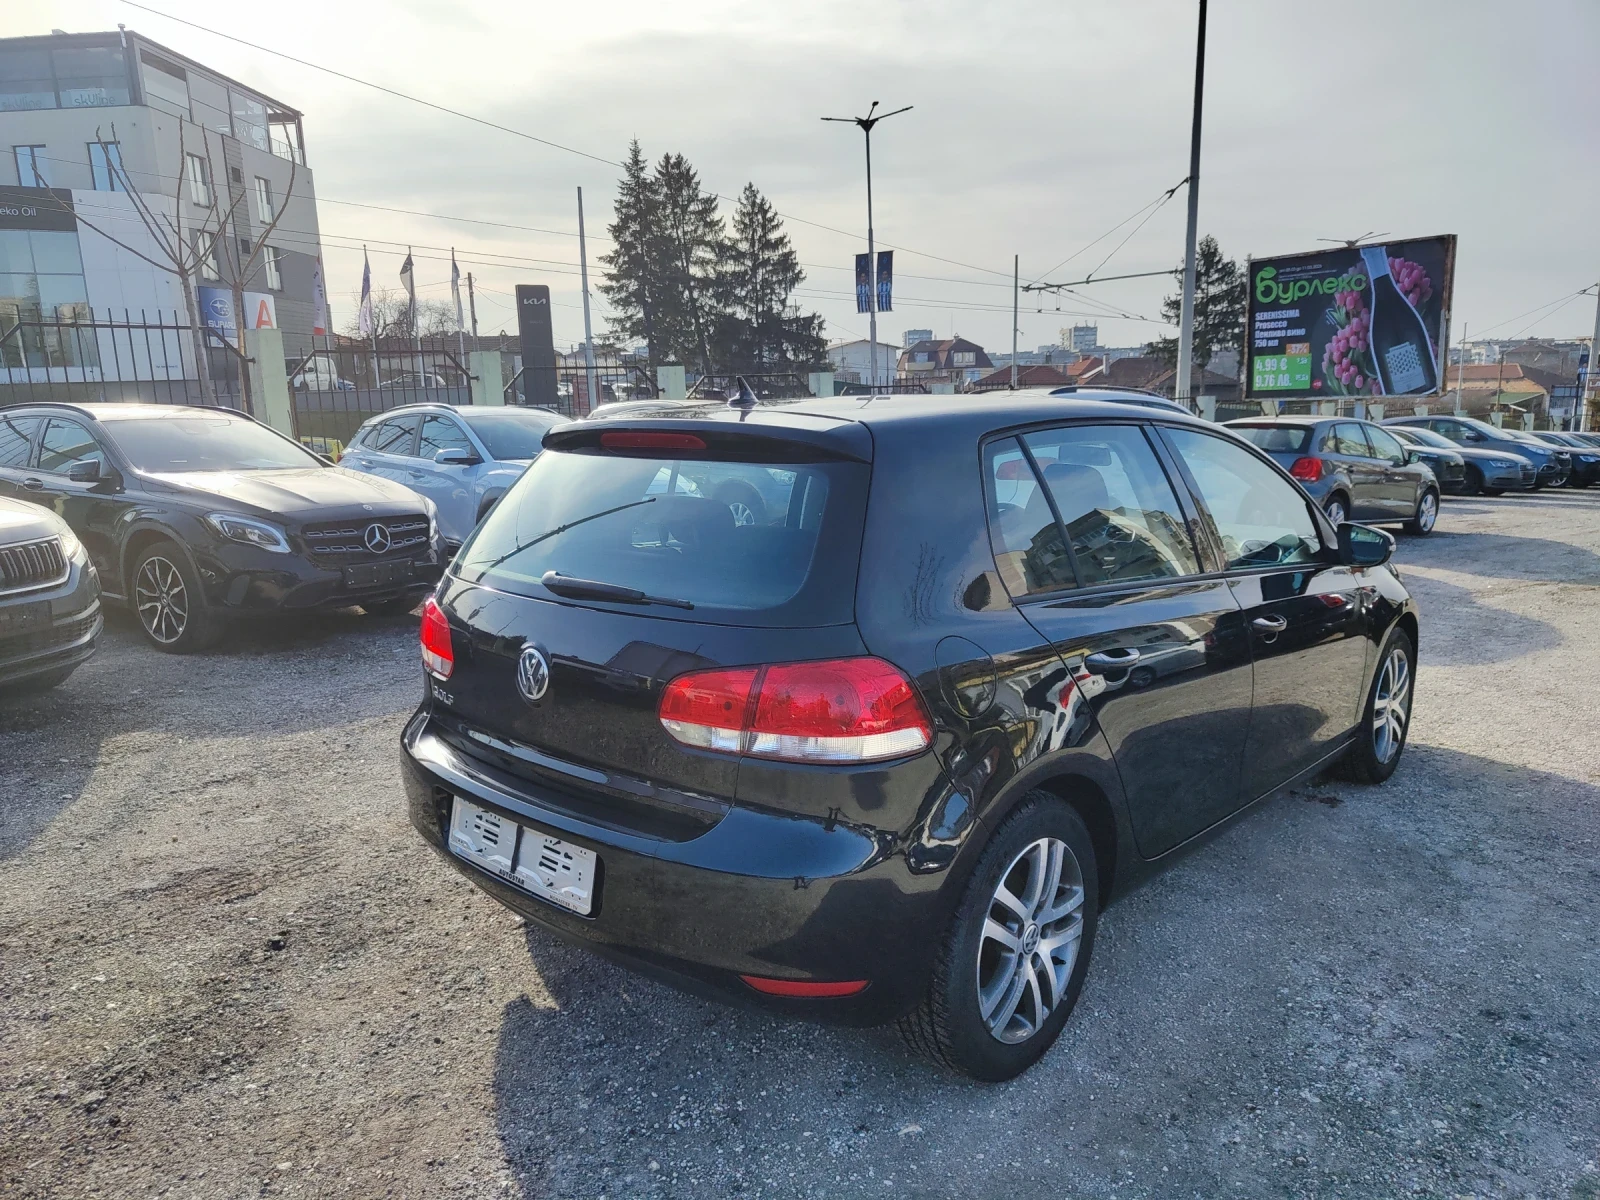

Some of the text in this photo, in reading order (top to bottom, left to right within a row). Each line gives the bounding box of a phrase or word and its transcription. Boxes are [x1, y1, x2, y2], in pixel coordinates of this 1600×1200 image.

[21, 207, 37, 217] Oil
[1255, 309, 1300, 321] SERENISSIMA
[1255, 320, 1287, 329] Prosecco
[1286, 328, 1306, 337] вино
[1255, 339, 1267, 348] 750
[1287, 344, 1308, 354] -37%
[1256, 358, 1288, 372] 4.99 €
[1256, 374, 1276, 388] 9.76
[498, 868, 525, 886] AUTOSTAR
